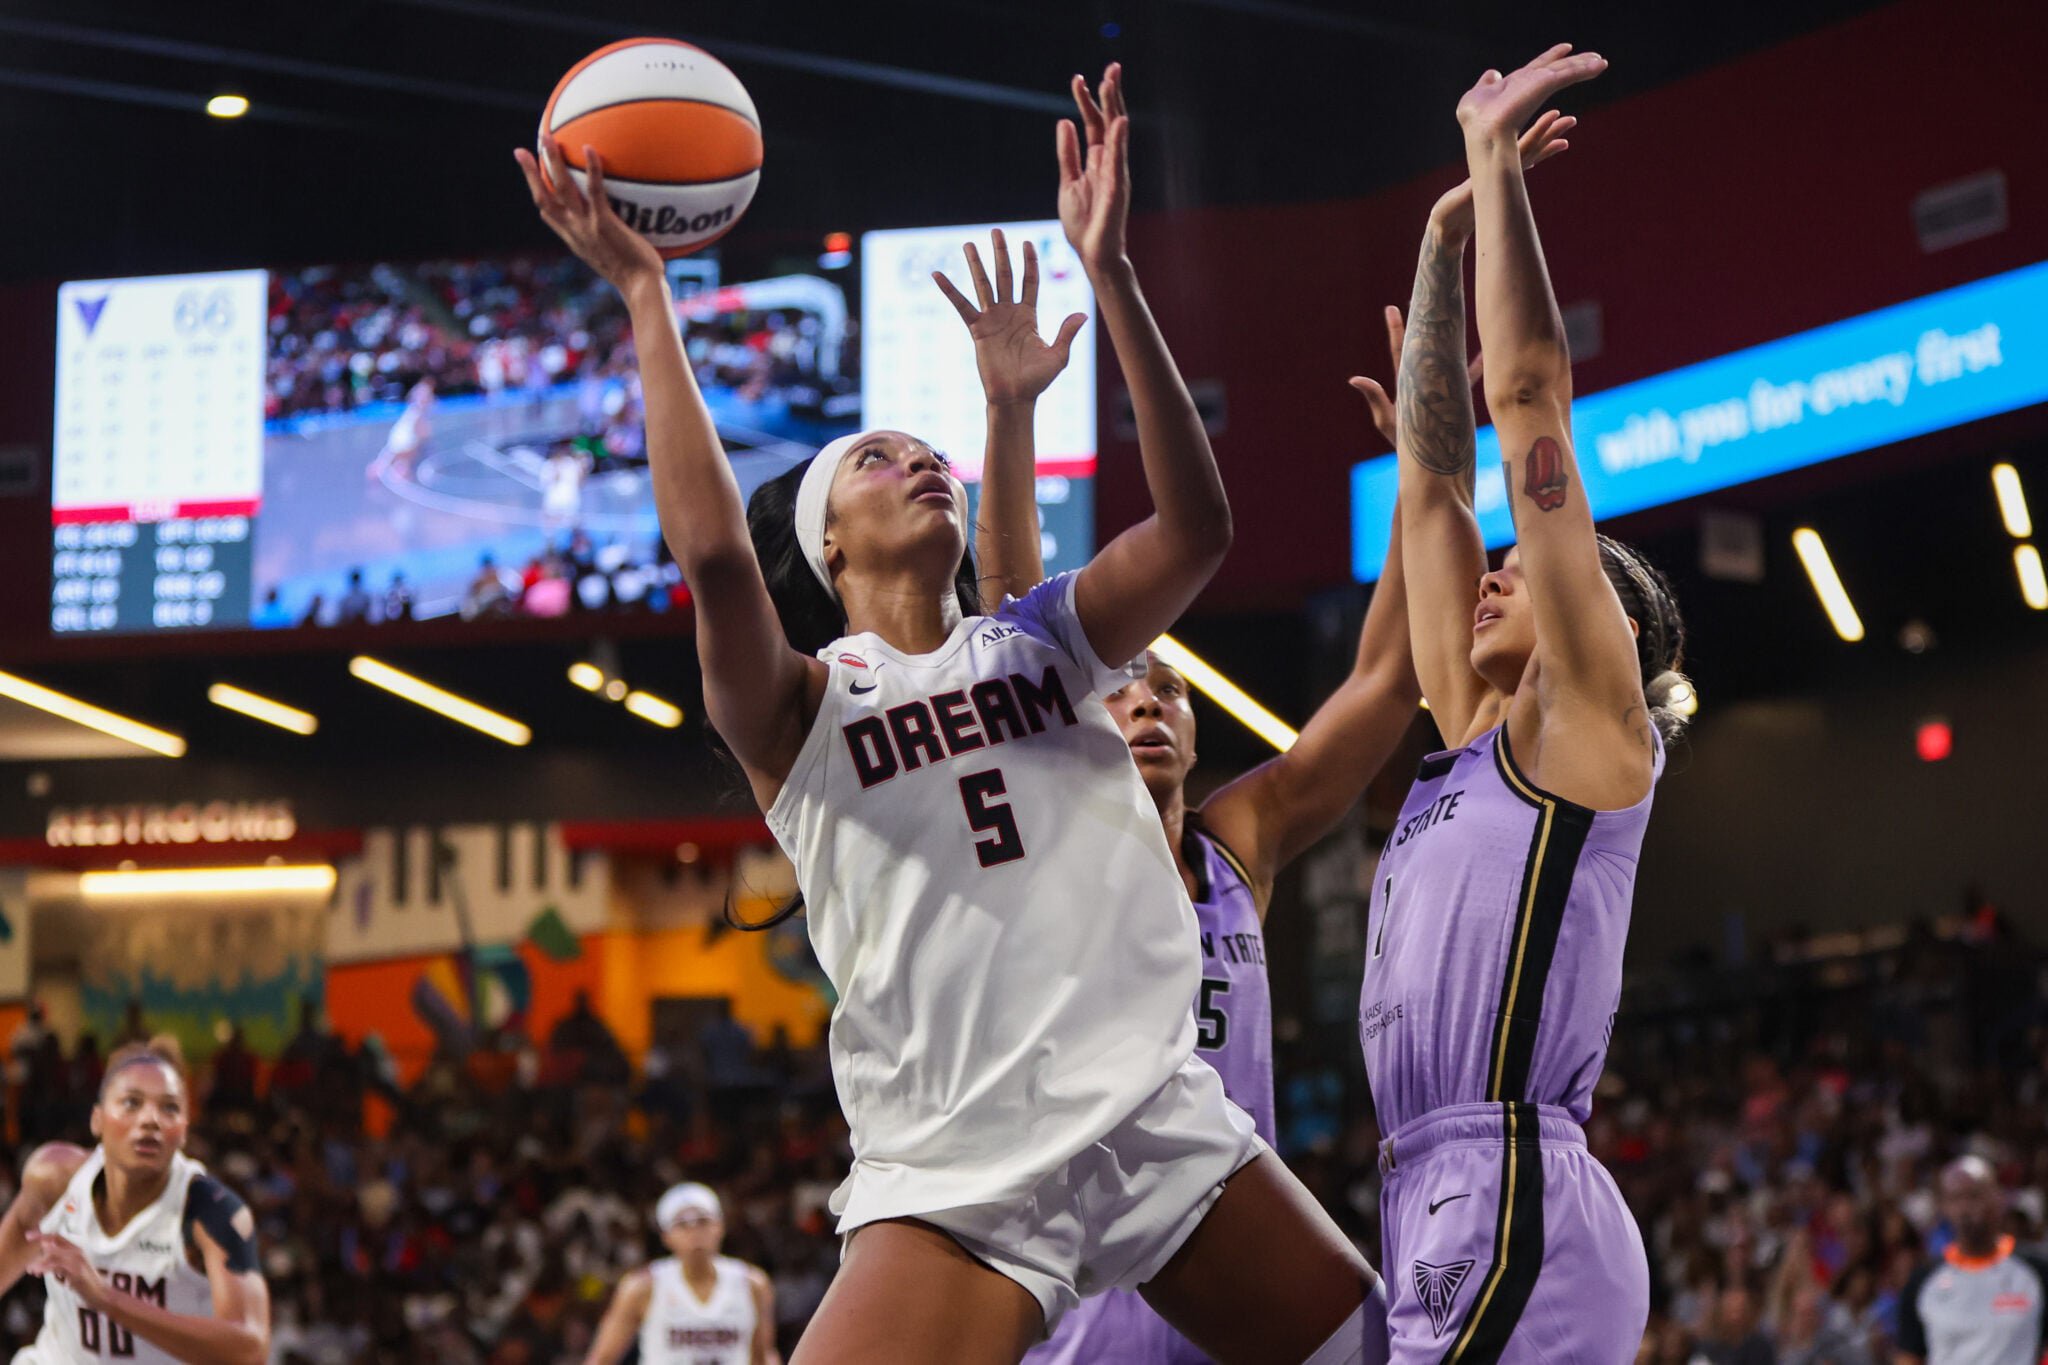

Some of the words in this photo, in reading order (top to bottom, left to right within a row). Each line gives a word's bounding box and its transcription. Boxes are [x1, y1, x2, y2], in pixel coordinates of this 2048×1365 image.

[608, 197, 734, 235] Wilson
[174, 287, 236, 337] 66
[1597, 409, 1682, 474] with
[1680, 398, 1750, 463] you
[1749, 378, 1808, 432] for
[1811, 351, 1914, 415] every
[1916, 324, 2001, 385] first
[842, 665, 1079, 790] DREAM
[958, 768, 1026, 869] 5
[1396, 790, 1465, 847] STATE
[1197, 978, 1231, 1051] 5
